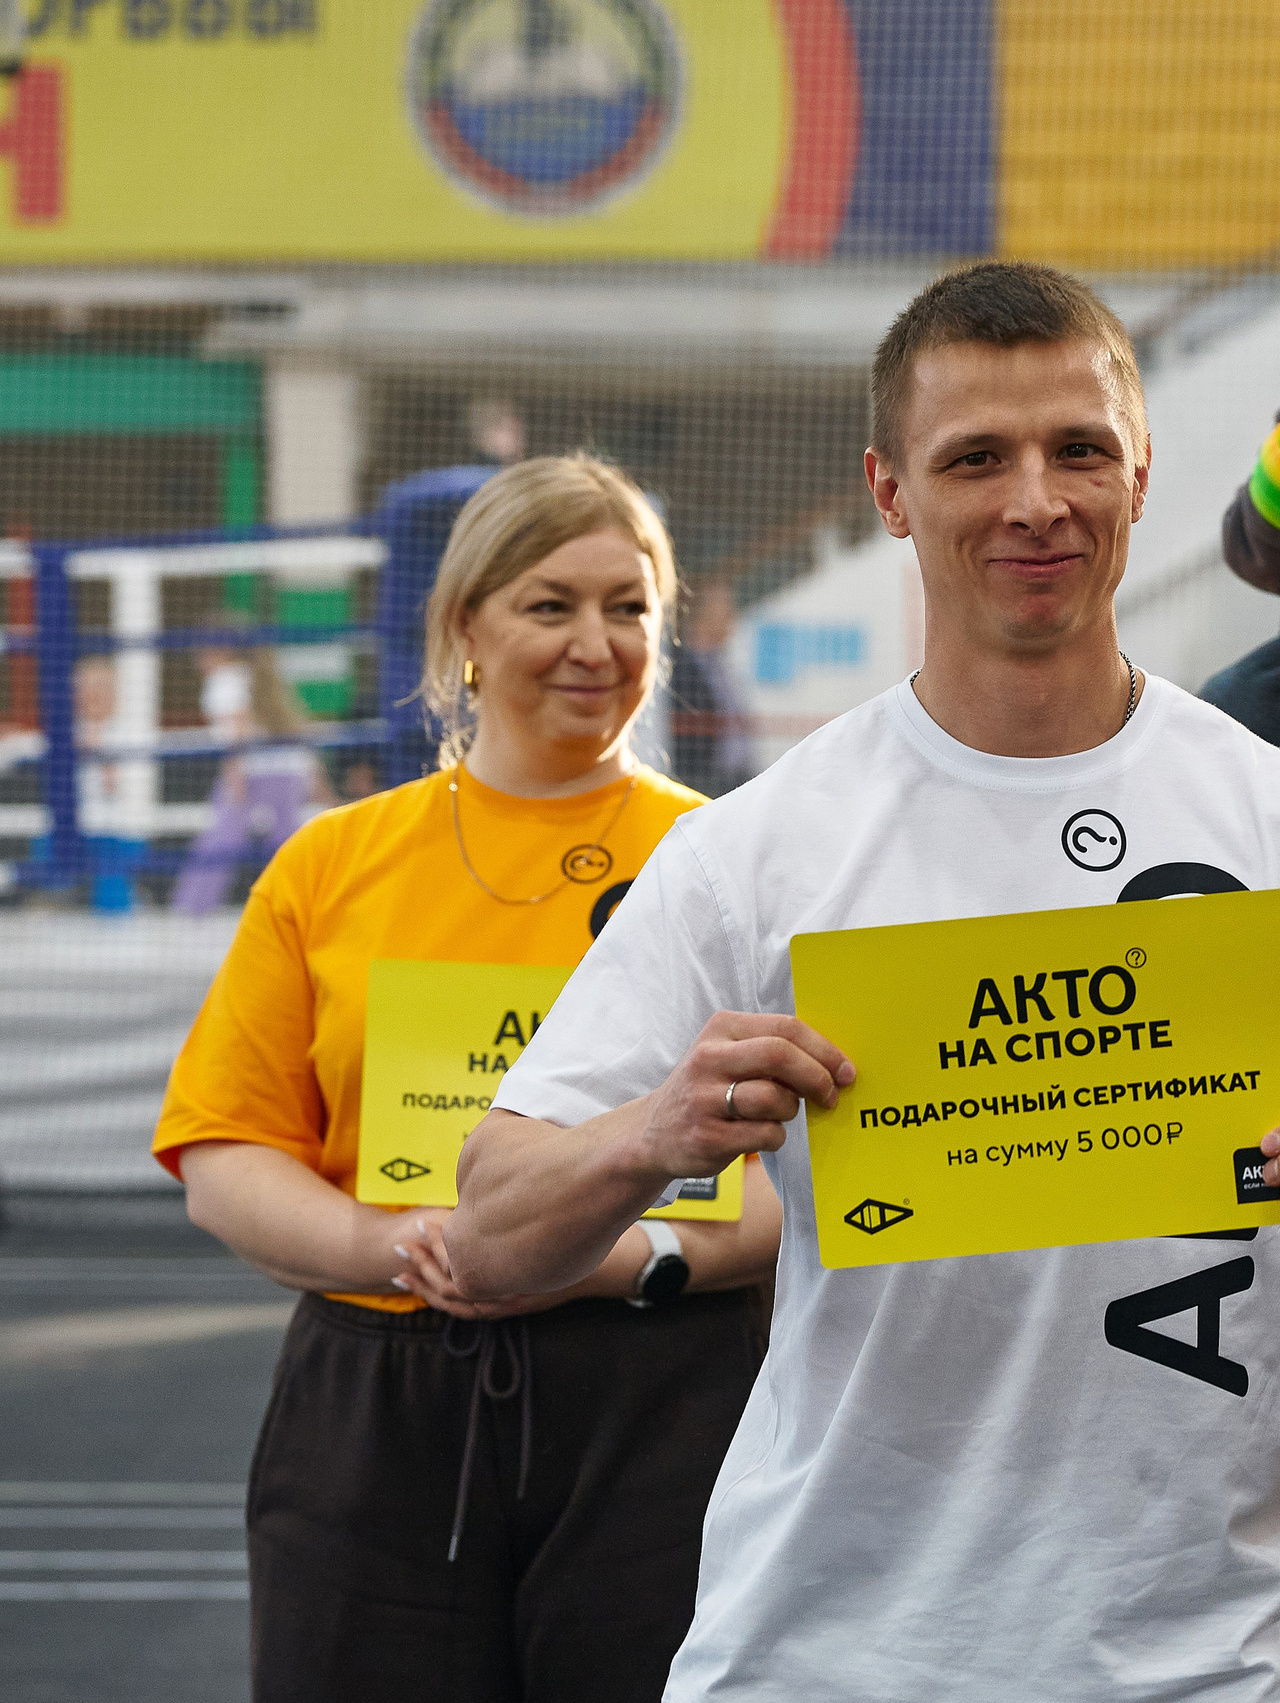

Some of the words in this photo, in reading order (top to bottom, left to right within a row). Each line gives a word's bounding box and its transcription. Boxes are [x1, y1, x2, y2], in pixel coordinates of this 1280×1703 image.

[968, 964, 1137, 1030] АКТО
[468, 1052, 510, 1074] НА
[938, 1037, 998, 1070] НА
[1005, 1019, 1173, 1063] СПОРТЕ
[402, 1092, 494, 1112] ПОДАРО
[859, 1083, 1067, 1129] ПОДАРОЧНЫЙ
[1073, 1070, 1261, 1108] СЕРТИФИКАТ
[947, 1148, 978, 1166] на
[985, 1138, 1069, 1167] сумму
[1077, 1130, 1093, 1153] 5
[1242, 1165, 1265, 1181] АК
